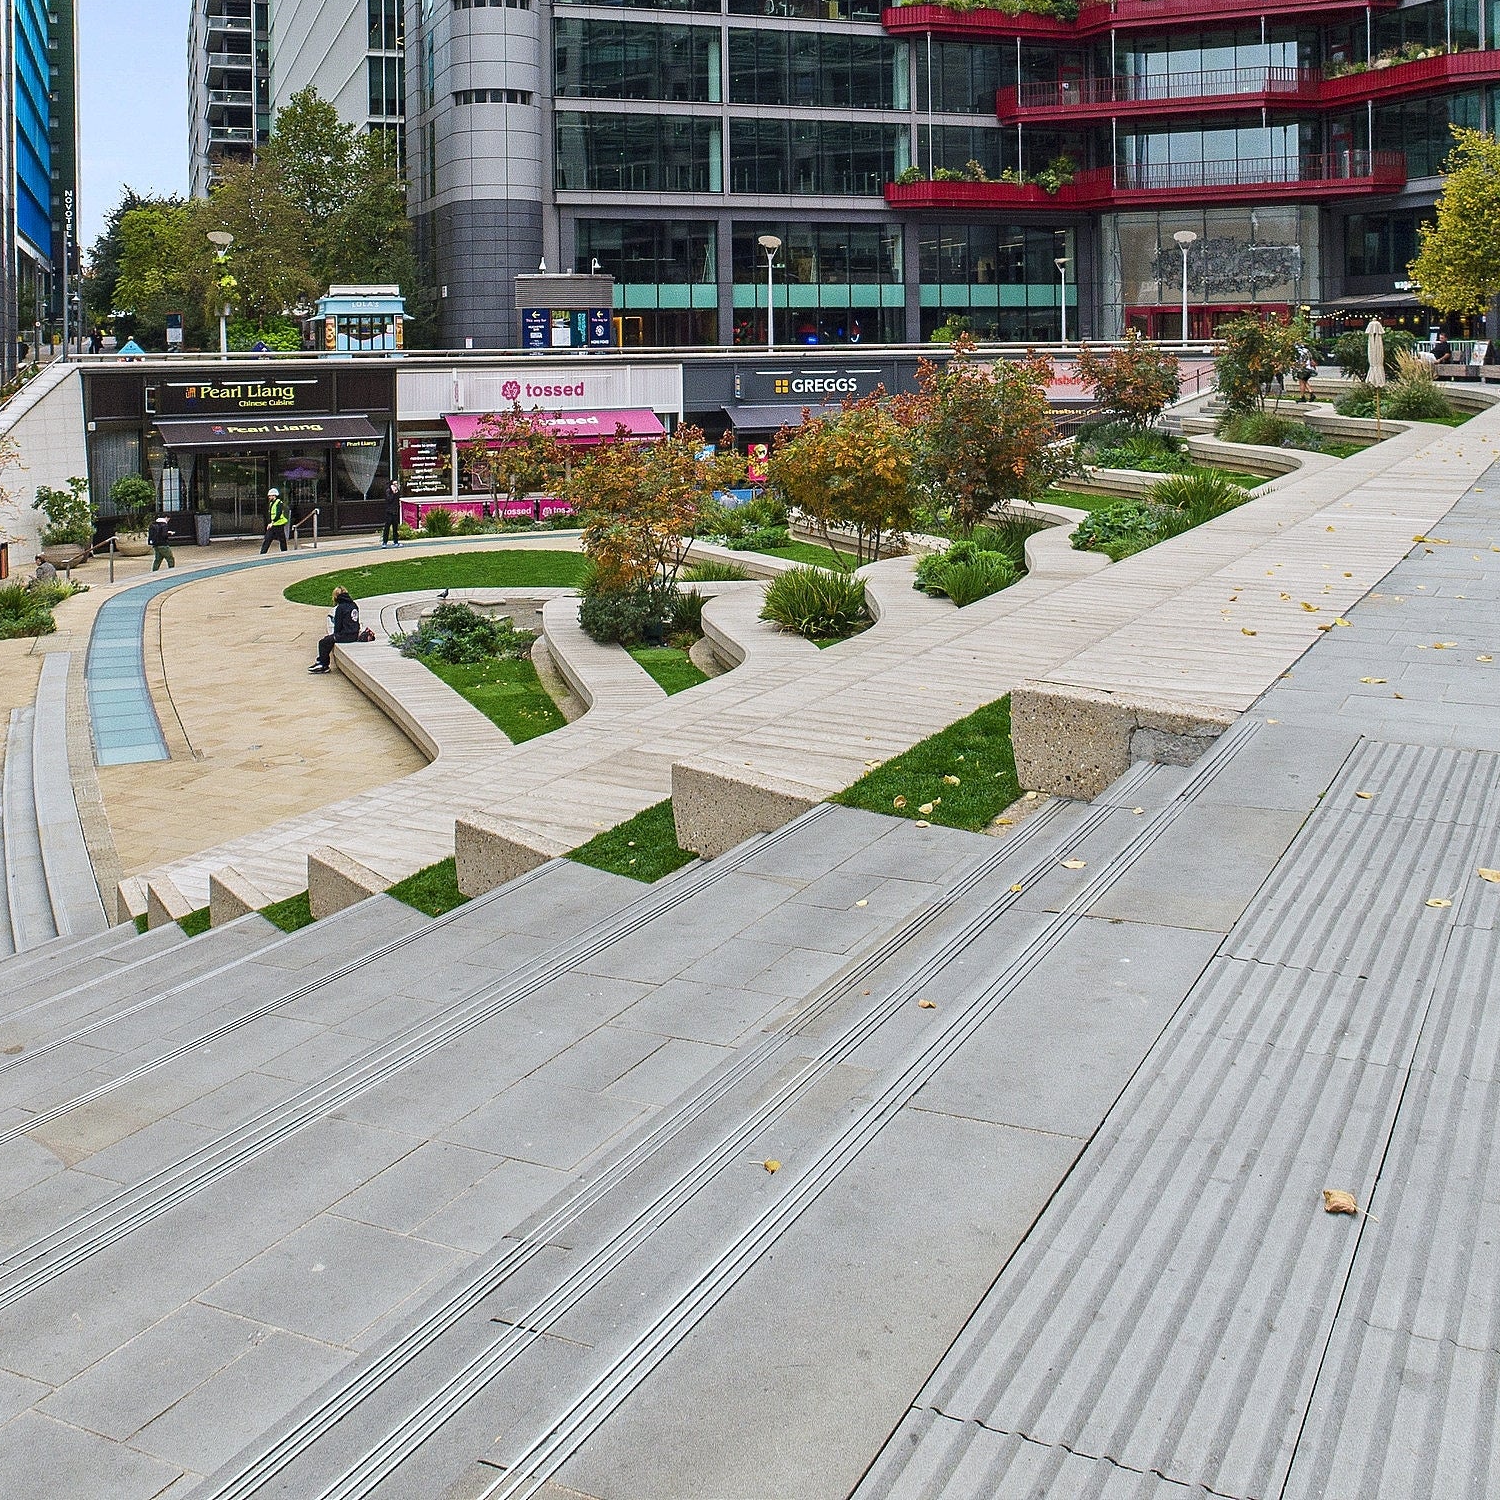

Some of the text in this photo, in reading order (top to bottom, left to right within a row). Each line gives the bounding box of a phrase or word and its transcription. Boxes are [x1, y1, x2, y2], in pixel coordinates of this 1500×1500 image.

[64, 189, 73, 238] NOVOTEL
[200, 385, 295, 400] Pearl Liang
[526, 381, 585, 397] tossed
[791, 378, 857, 393] GREGGS
[268, 399, 295, 407] Cuisine
[226, 423, 324, 433] Pearl Liang
